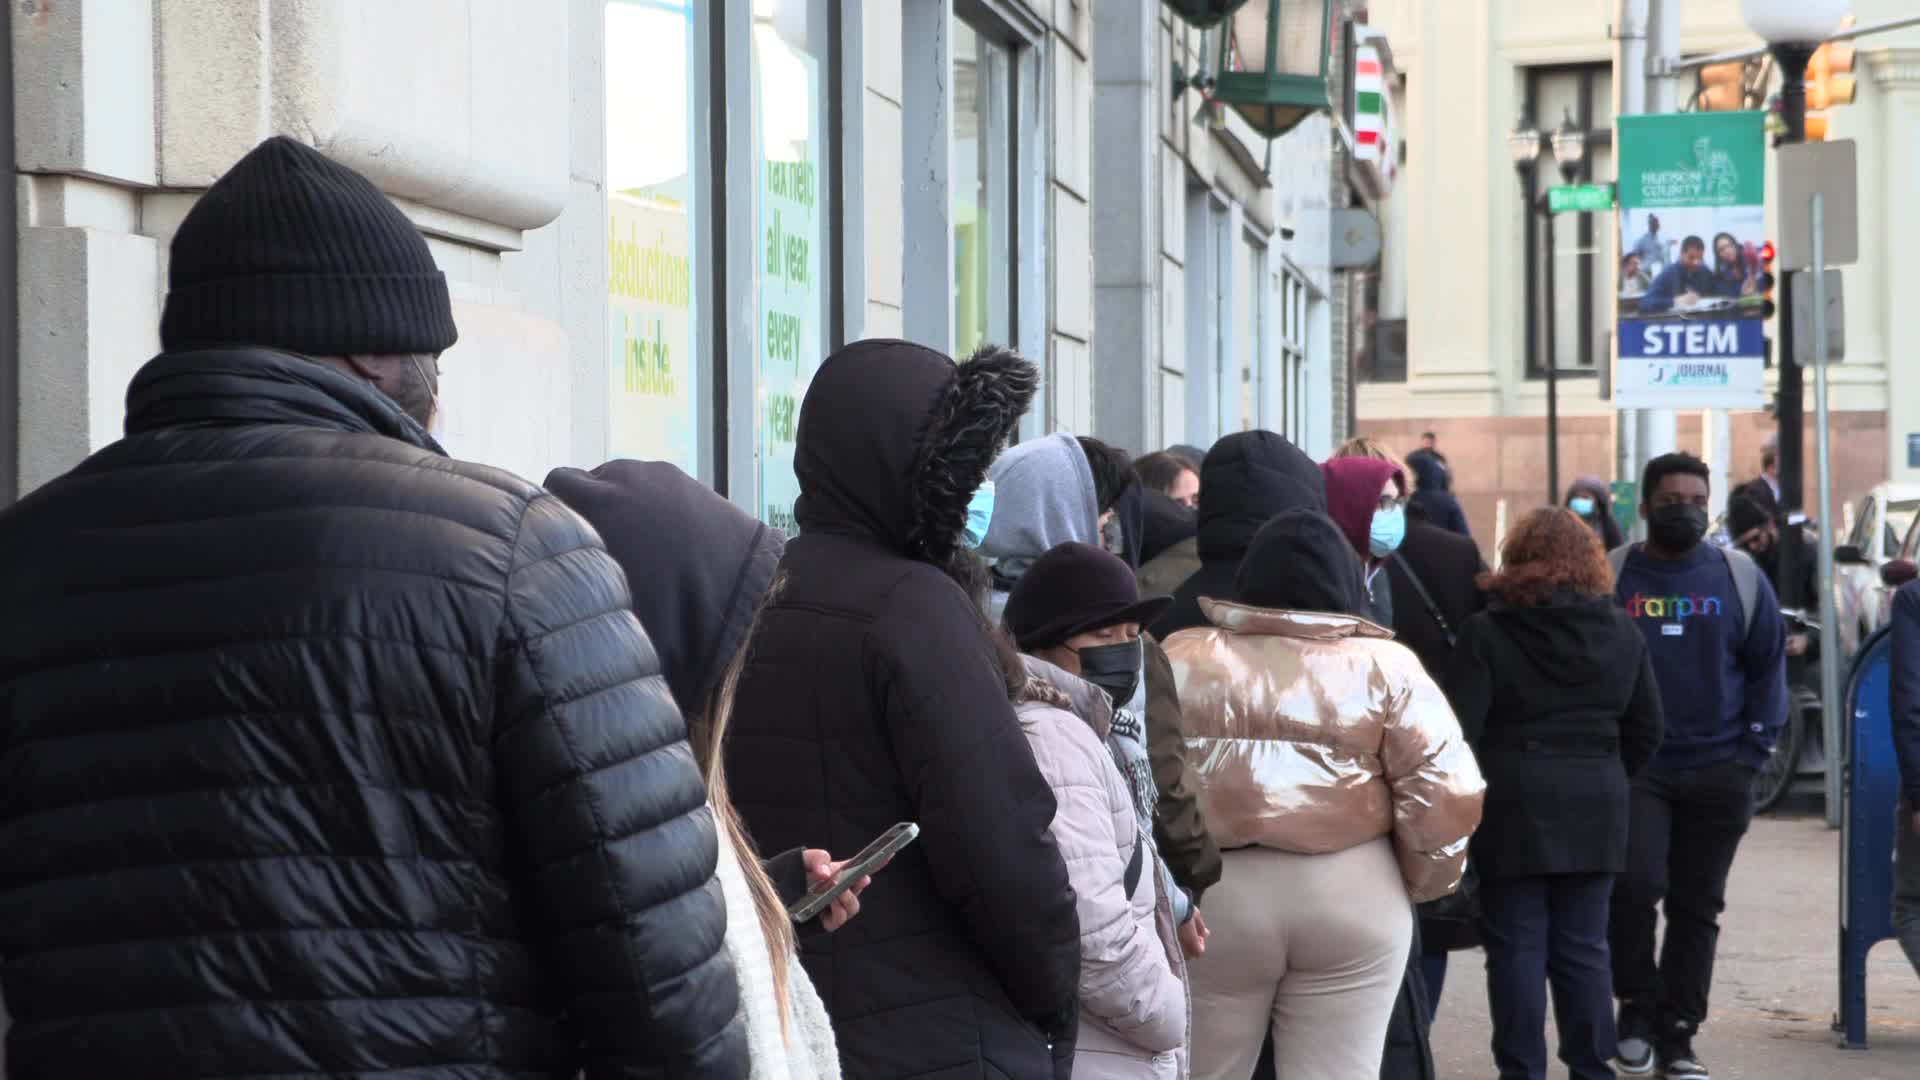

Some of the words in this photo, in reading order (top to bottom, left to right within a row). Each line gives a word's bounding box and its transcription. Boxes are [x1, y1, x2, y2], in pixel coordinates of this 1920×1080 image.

[767, 211, 781, 276] all
[767, 309, 801, 377] every
[1642, 323, 1739, 355] STEM
